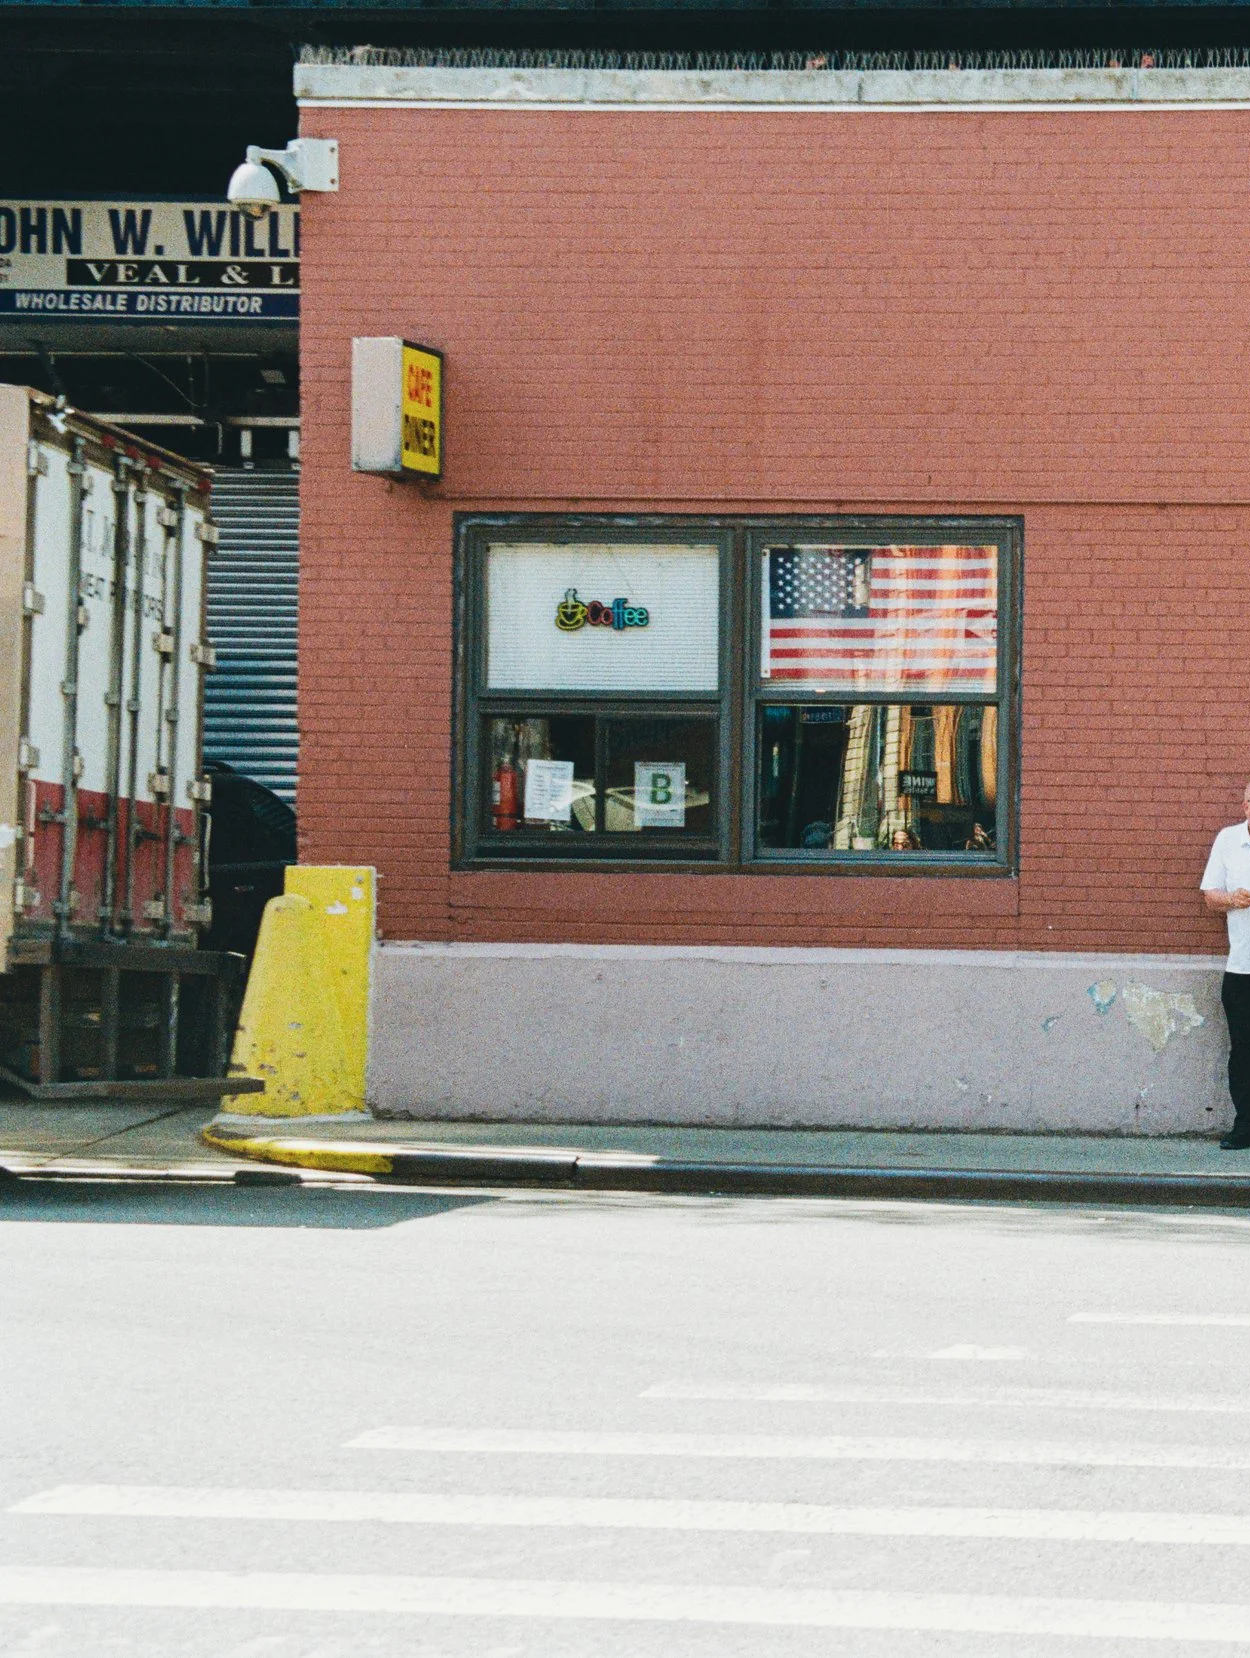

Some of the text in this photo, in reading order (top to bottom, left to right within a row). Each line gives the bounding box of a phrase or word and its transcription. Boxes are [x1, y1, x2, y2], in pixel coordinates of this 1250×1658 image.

[108, 208, 165, 255] W.
[86, 262, 200, 284] VEAL
[220, 264, 250, 285] &
[15, 292, 263, 314] WHOLESALE DISTRIBUTOR
[585, 597, 650, 630] Coffee
[650, 773, 672, 805] B
